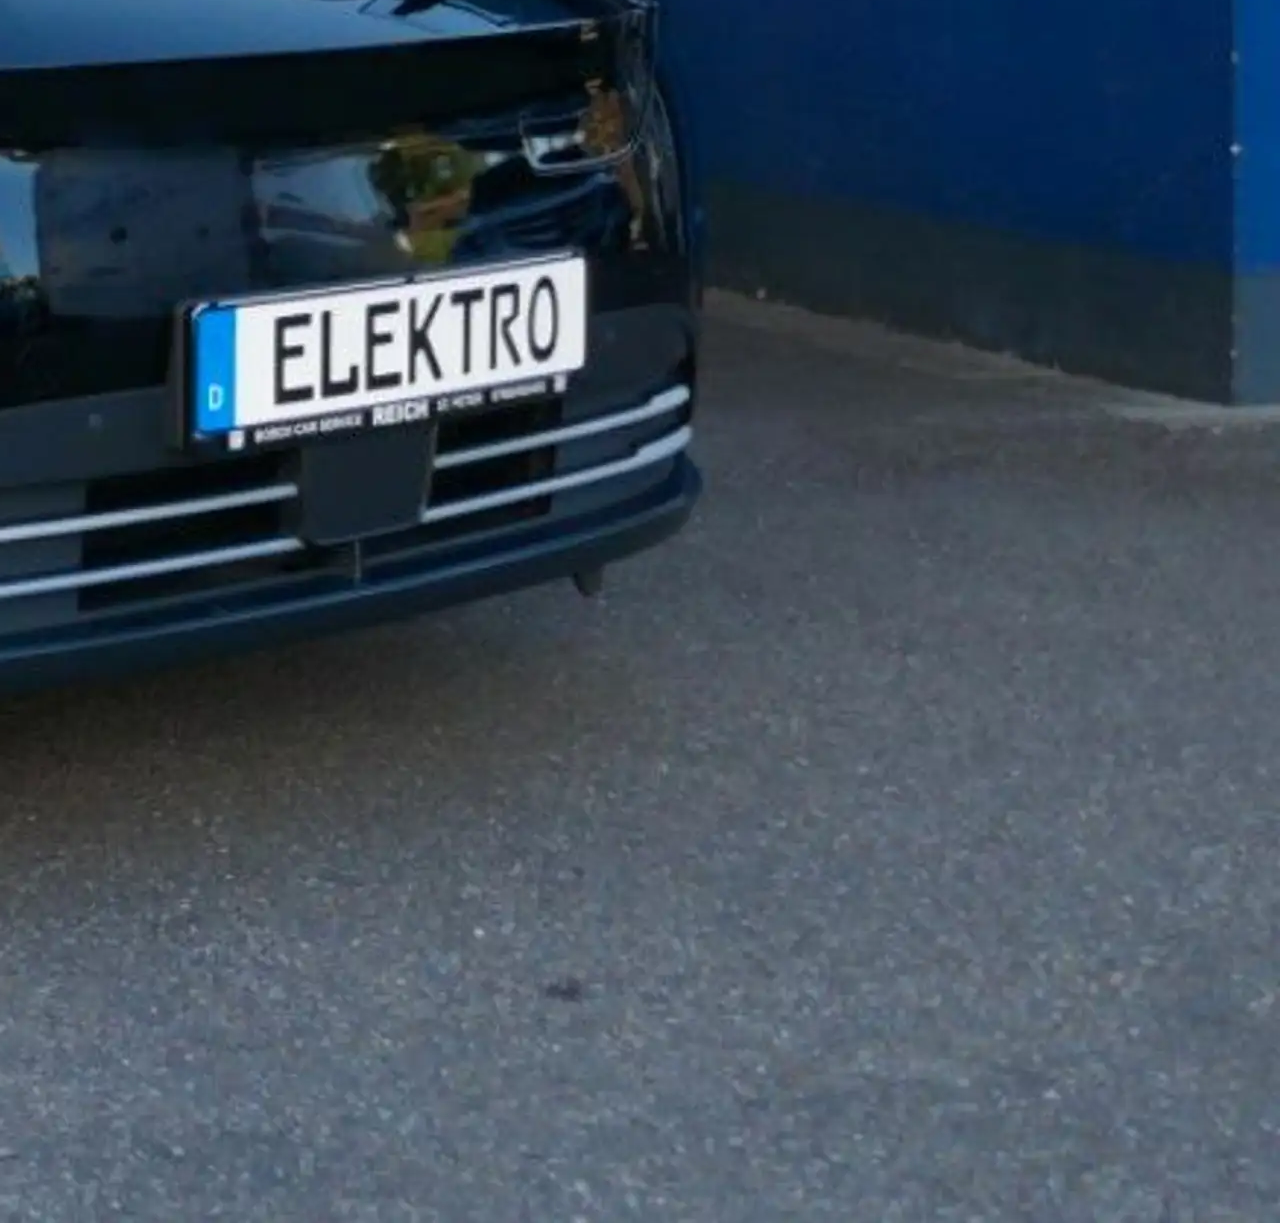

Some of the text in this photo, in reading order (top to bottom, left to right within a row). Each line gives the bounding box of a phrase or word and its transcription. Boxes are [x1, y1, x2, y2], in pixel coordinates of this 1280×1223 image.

[274, 275, 559, 405] ELEKTRO
[207, 384, 224, 412] D
[372, 399, 430, 427] REICH
